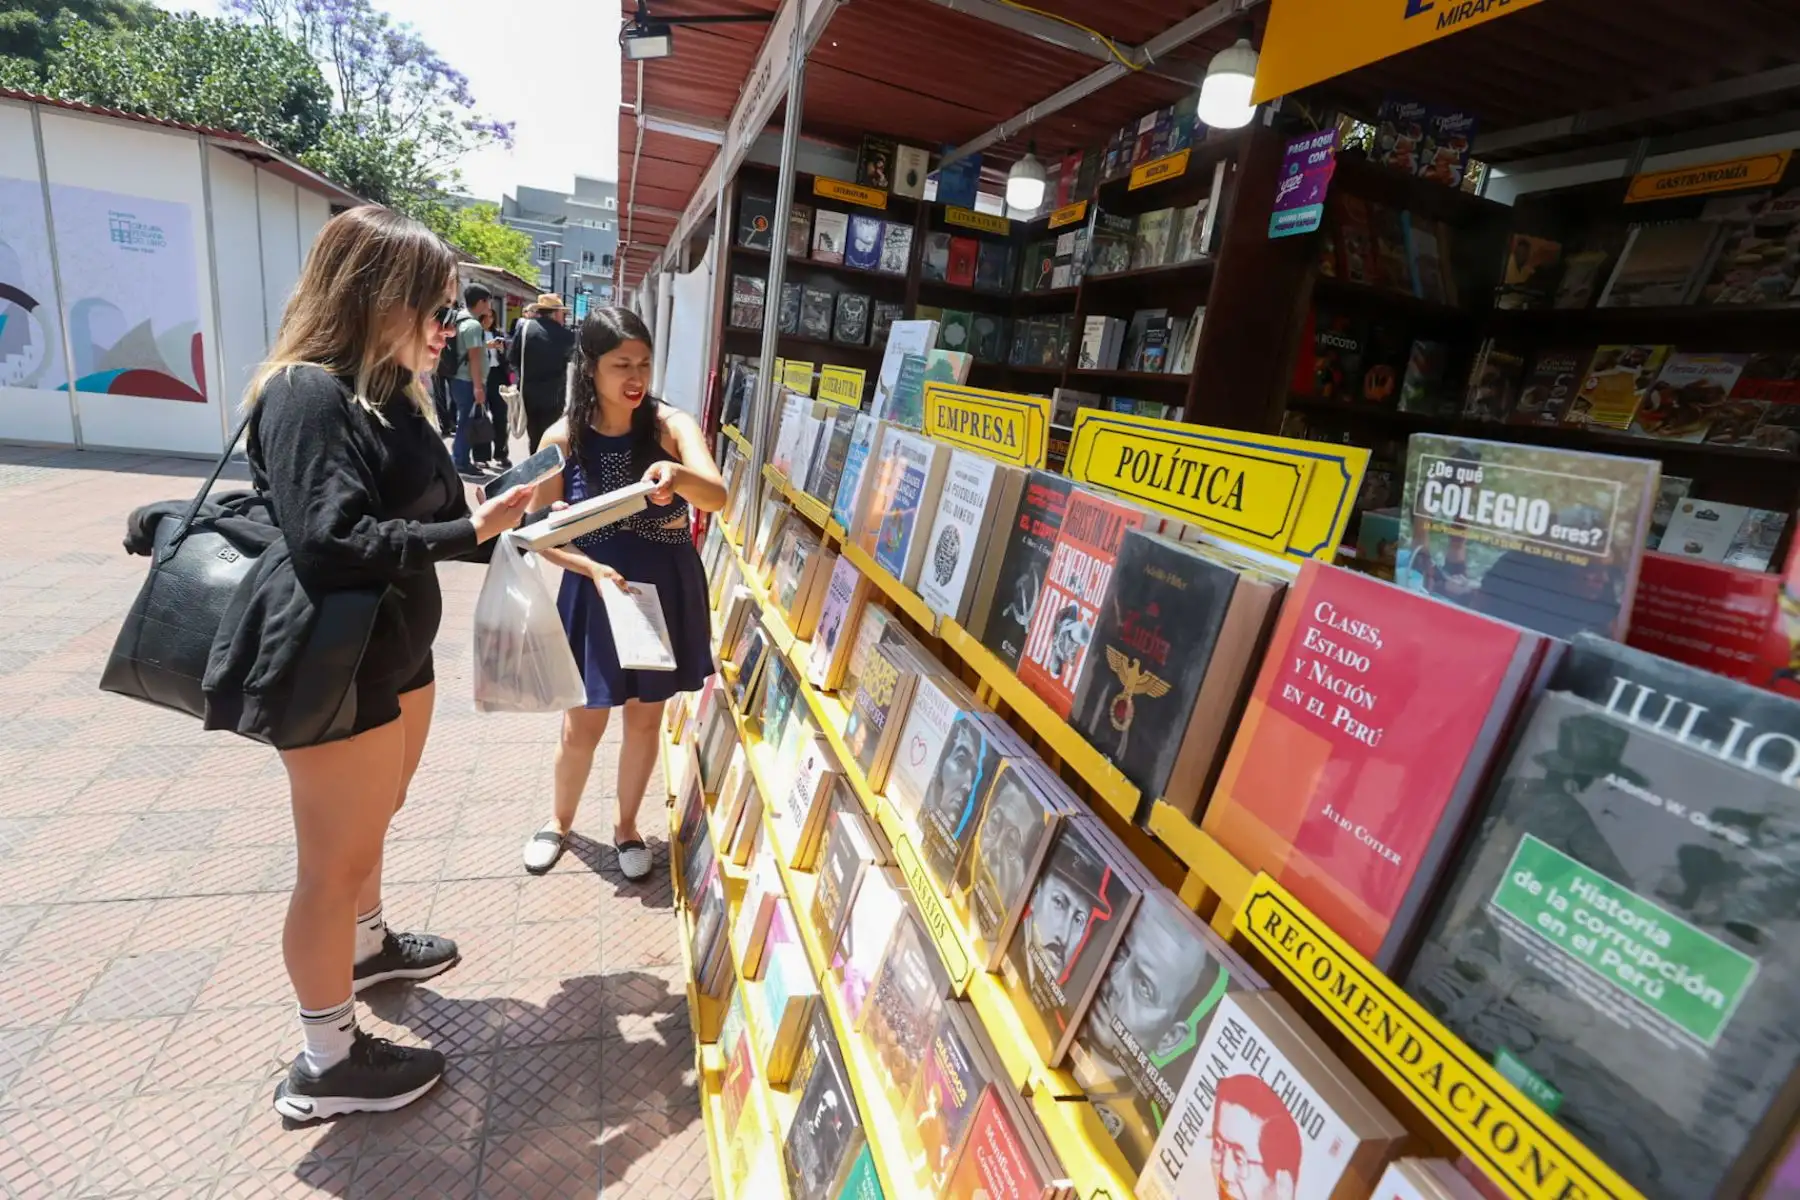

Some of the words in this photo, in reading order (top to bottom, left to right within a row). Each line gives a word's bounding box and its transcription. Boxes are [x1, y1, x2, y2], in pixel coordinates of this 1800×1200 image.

[1308, 151, 1326, 165] CON
[1655, 163, 1748, 190] GASTRONOMÍA
[1321, 333, 1357, 351] ROCOTO
[936, 404, 1017, 448] EMPRESA
[1113, 446, 1245, 513] POLÍTICA
[1427, 460, 1453, 480] ¿De
[1456, 466, 1483, 485] qué
[1423, 480, 1550, 537] COLEGIO
[1550, 522, 1603, 547] eres?
[1049, 541, 1115, 608] GENERACIÓ
[1302, 626, 1371, 674] ESTADO
[1313, 600, 1384, 650] CLASES,
[1293, 657, 1306, 674] Y
[1307, 659, 1377, 711] NACIÓN
[1281, 683, 1304, 705] EN
[1306, 697, 1327, 719] EL
[1331, 703, 1384, 748] PERÚ
[1320, 803, 1353, 832] JULIO
[1353, 824, 1402, 867] COTLER
[911, 866, 947, 939] ENSAYOS
[1569, 877, 1671, 948] Historia
[1512, 868, 1543, 896] de
[1546, 887, 1569, 913] la
[1572, 907, 1725, 1010] corrupción
[1537, 911, 1566, 937] en
[1571, 932, 1598, 956] el
[1599, 946, 1667, 1001] Perú
[1110, 1016, 1127, 1037] LOS
[1121, 1028, 1140, 1055] AÑOS
[1136, 1048, 1149, 1066] DE
[1146, 1061, 1177, 1104] VELASCO
[1216, 1016, 1248, 1061] ERA
[1207, 1053, 1230, 1091] LA
[1241, 1035, 1272, 1081] DEL
[1271, 1069, 1327, 1141] CHINO
[1193, 1083, 1217, 1117] EN
[1173, 1105, 1205, 1157] PERÚ
[1159, 1147, 1178, 1181] EL
